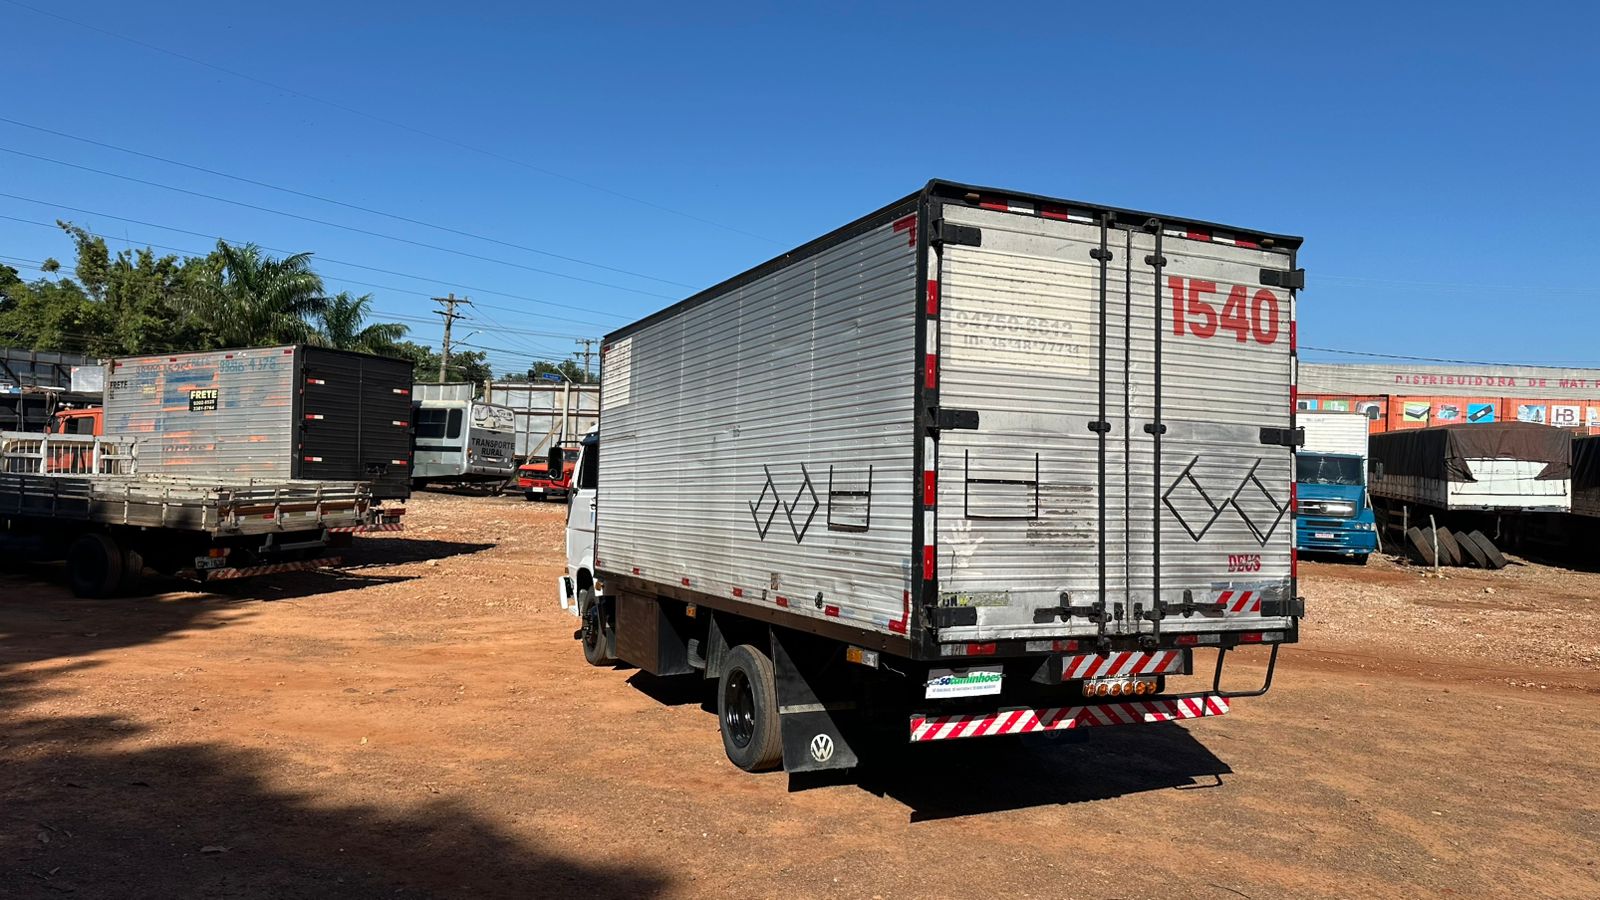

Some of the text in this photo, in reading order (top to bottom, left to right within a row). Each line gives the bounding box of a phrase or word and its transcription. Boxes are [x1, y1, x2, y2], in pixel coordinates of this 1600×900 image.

[1168, 275, 1279, 345] 1540
[109, 380, 128, 389] FRETE
[1395, 375, 1516, 387] DISTRIBUIDORA
[1528, 379, 1546, 387] DE
[190, 390, 218, 400] FRETE
[471, 437, 515, 449] TRANSPORTE
[481, 447, 503, 456] RURAL
[1228, 554, 1261, 572] DEUS
